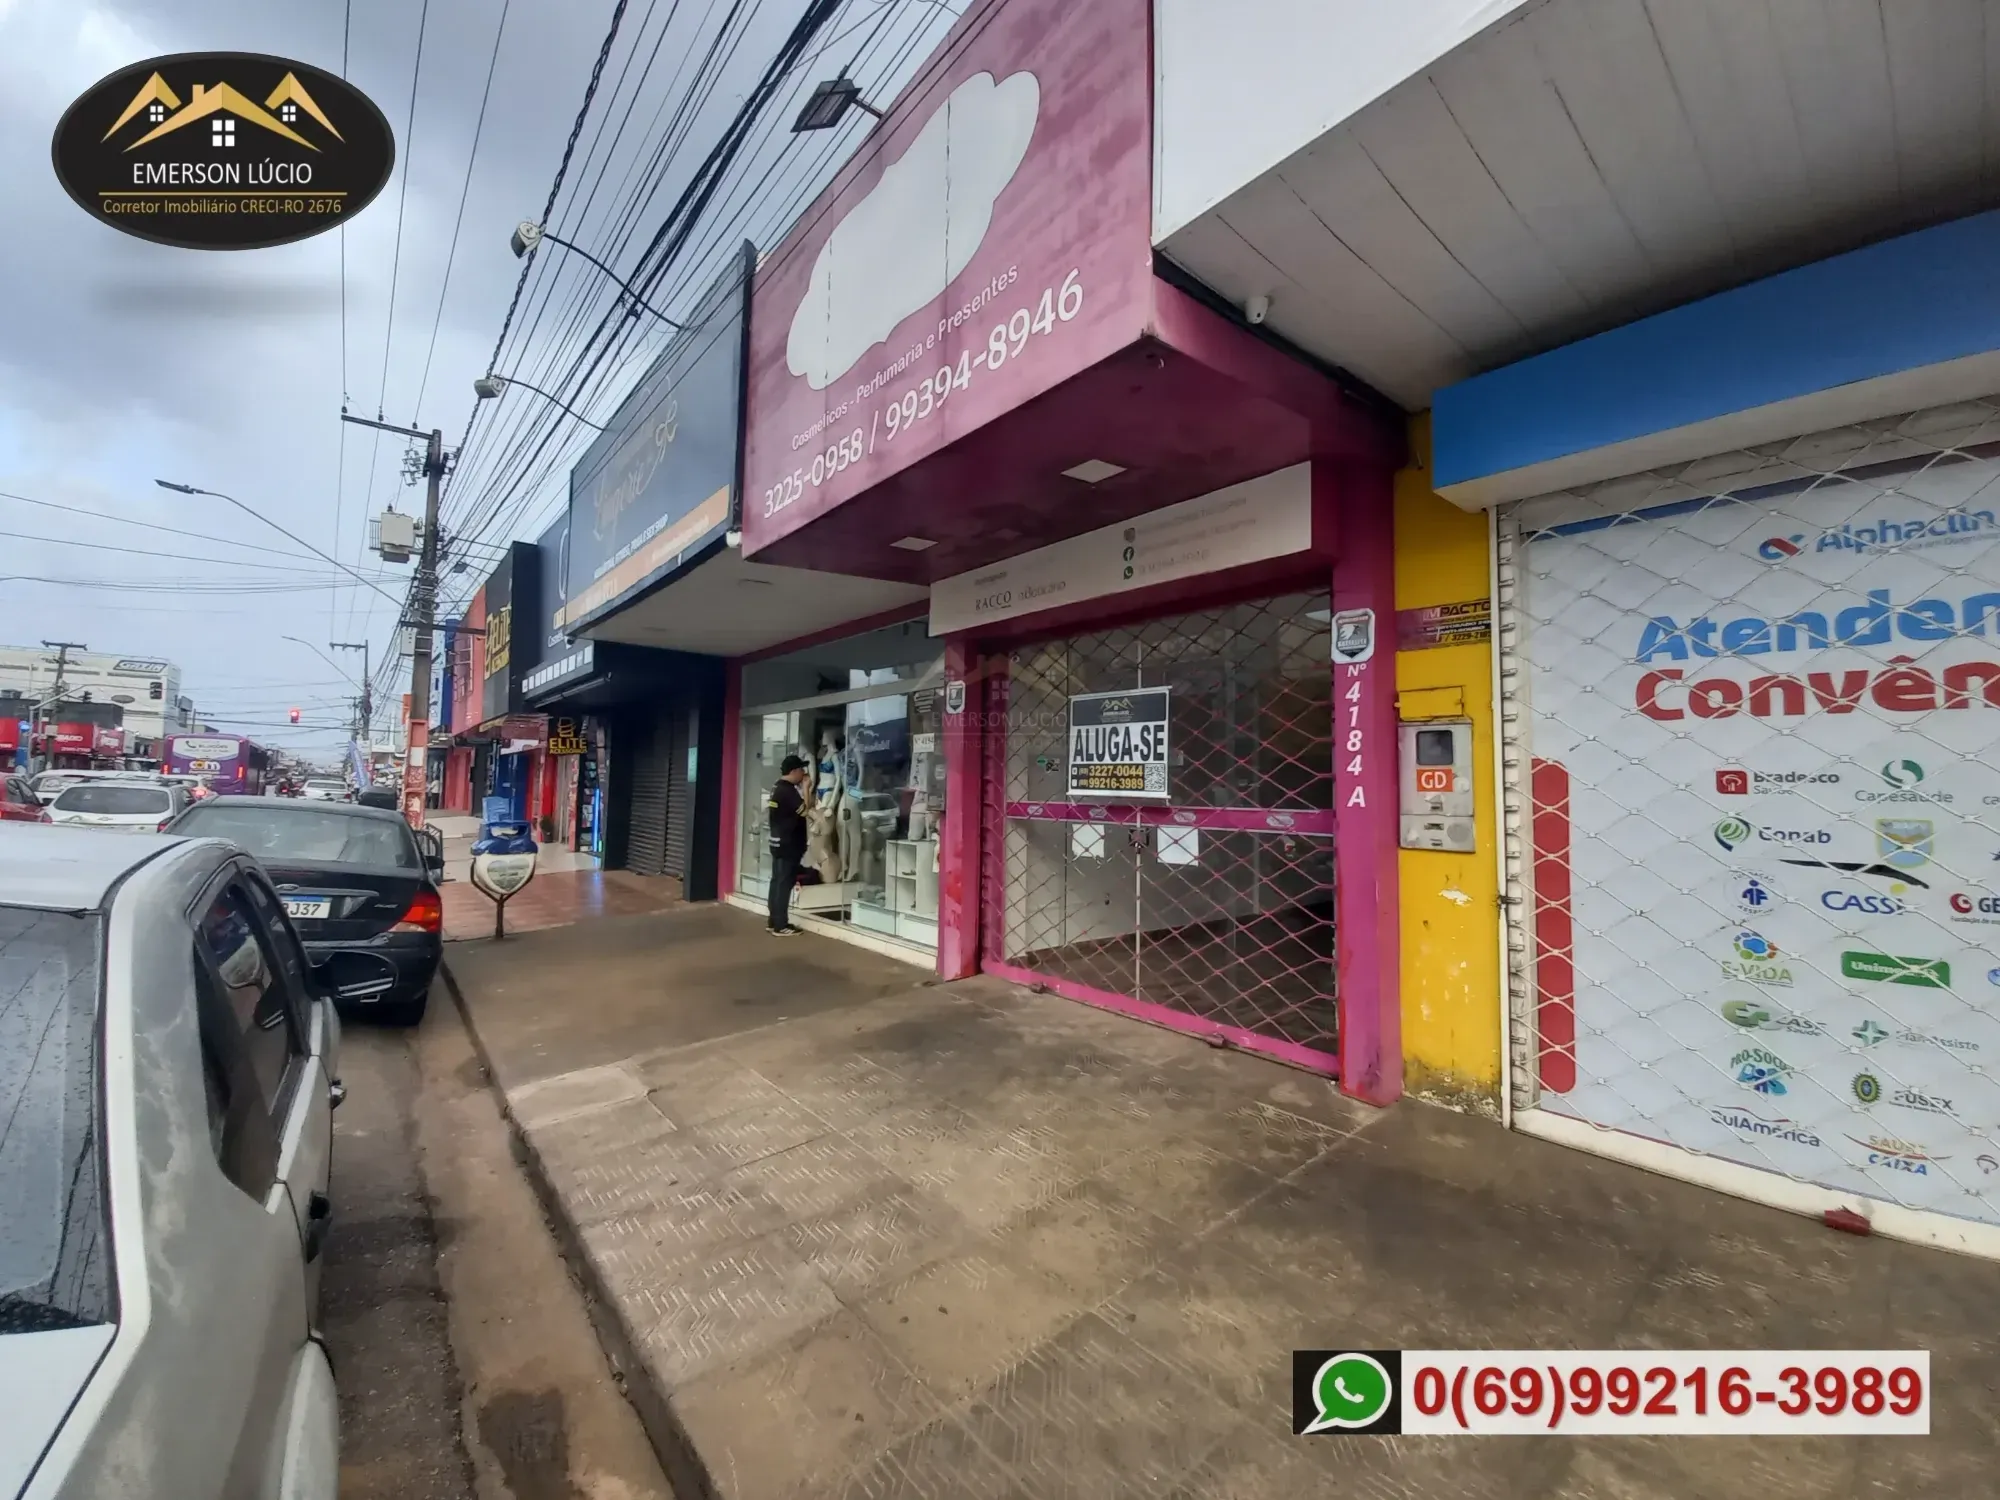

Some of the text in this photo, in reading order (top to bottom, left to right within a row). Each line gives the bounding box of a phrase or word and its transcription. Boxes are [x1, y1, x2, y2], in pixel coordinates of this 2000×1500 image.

[855, 342, 923, 405] Perfumaria
[925, 333, 935, 350] e
[937, 264, 1019, 342] Presentes
[763, 426, 864, 520] 3225-0958
[885, 267, 1085, 442] 99394-8946
[1345, 681, 1363, 776] 4184
[549, 737, 588, 749] ELITE
[1073, 724, 1165, 762] ALUGA-SE
[1089, 764, 1144, 777] 3227-0044
[1089, 777, 1144, 790] 99216-3989
[1347, 786, 1366, 808] A
[1758, 826, 1832, 845] Conab
